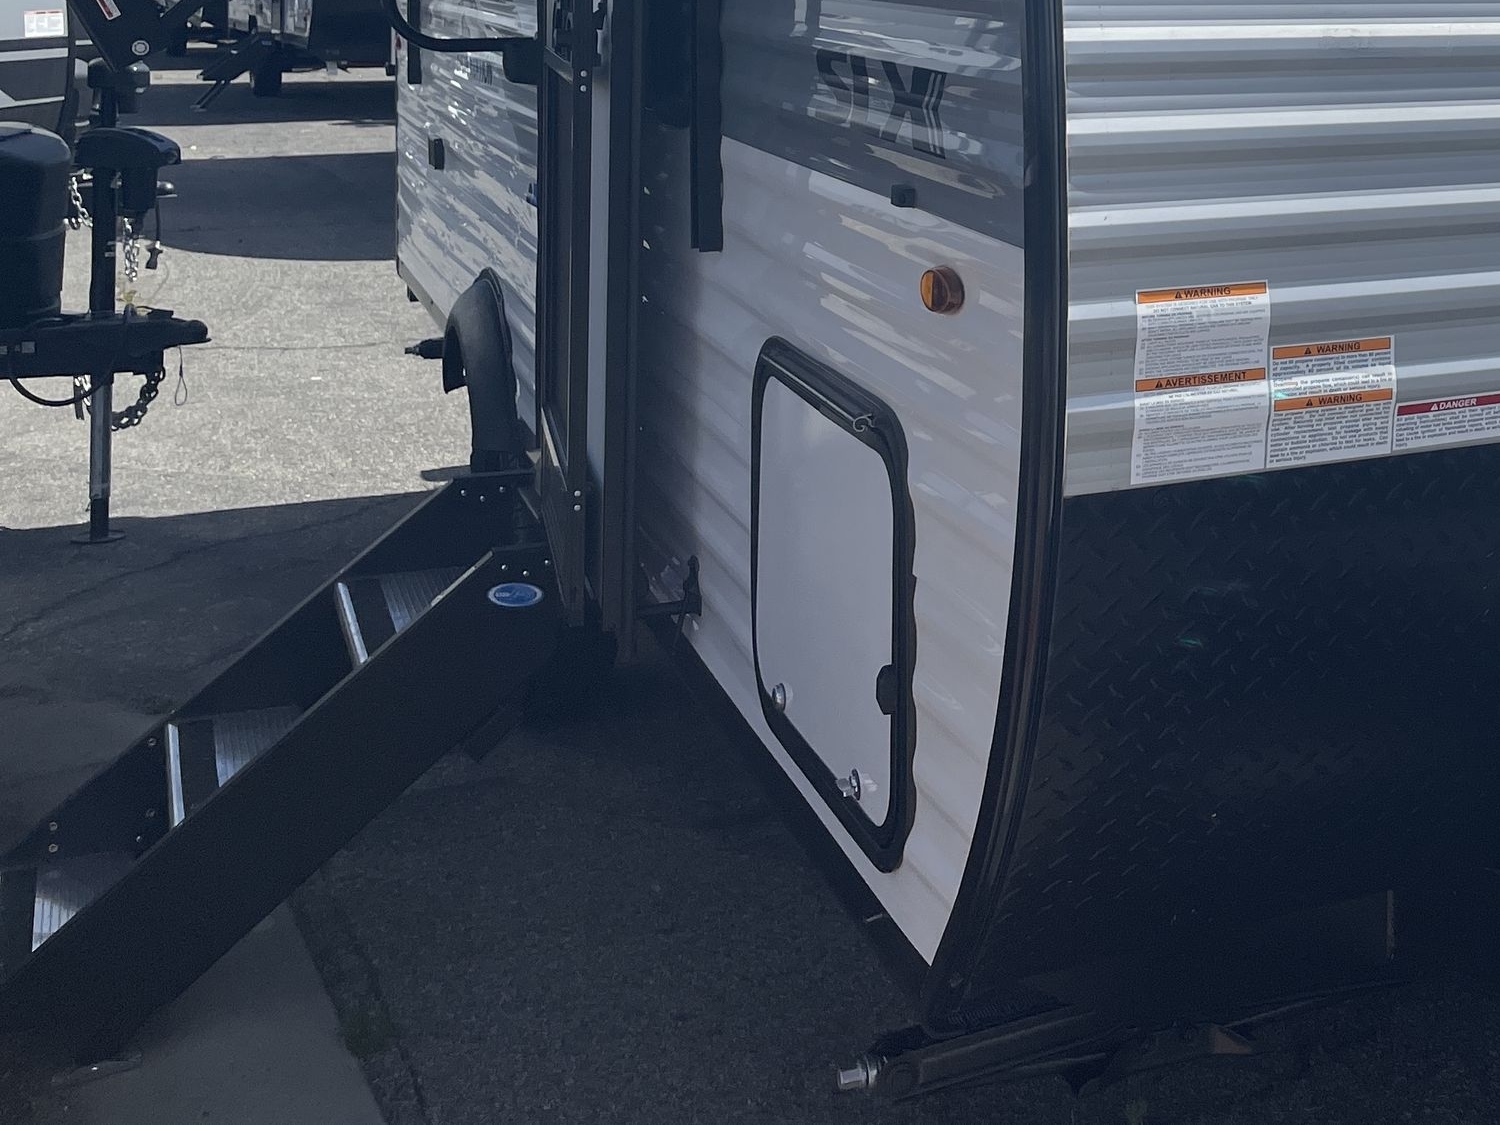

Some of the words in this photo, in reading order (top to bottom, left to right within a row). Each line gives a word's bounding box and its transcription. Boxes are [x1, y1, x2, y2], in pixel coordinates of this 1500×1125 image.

[1183, 287, 1231, 299] WARNING
[1317, 342, 1360, 354] WARNING
[1165, 372, 1247, 387] AVERTISSEMENT
[1318, 394, 1362, 405] WARNING
[1440, 398, 1477, 410] DANGER
